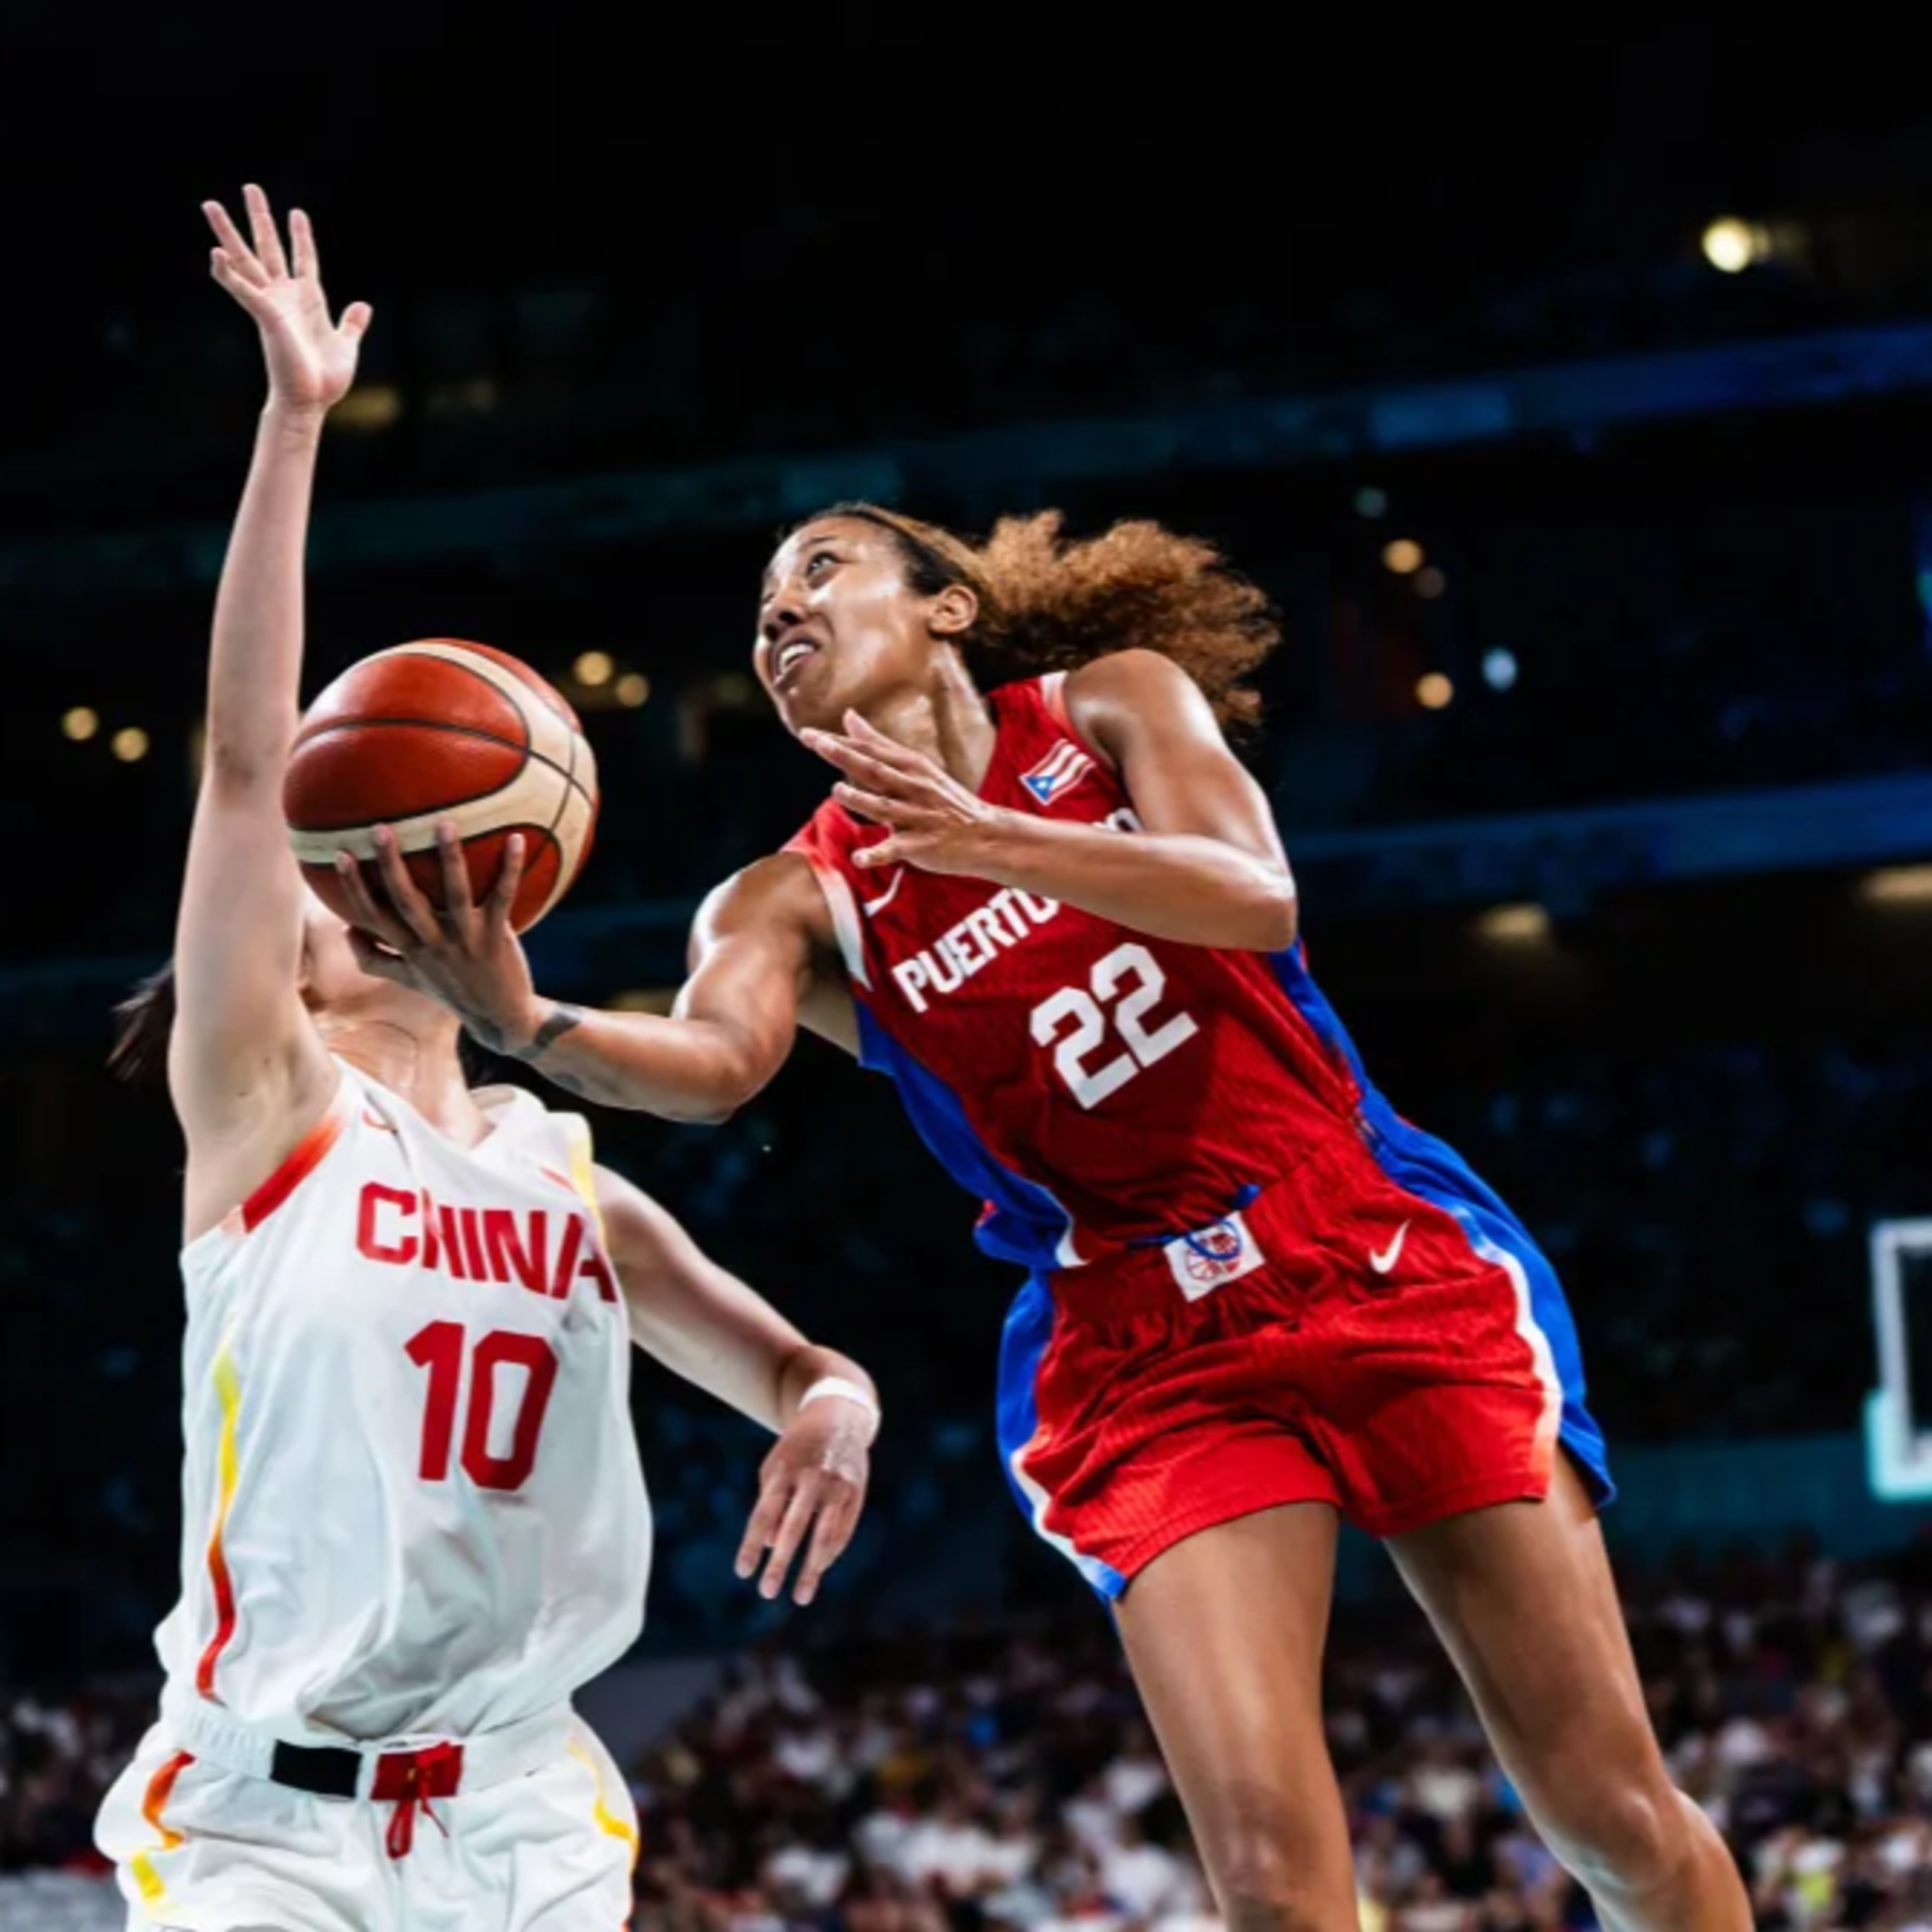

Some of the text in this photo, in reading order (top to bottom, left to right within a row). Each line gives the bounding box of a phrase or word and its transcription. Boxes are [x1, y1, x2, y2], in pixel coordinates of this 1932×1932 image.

[1030, 943, 1198, 1110] 22
[355, 1181, 617, 1303] CHINA
[403, 1320, 559, 1492] 10
